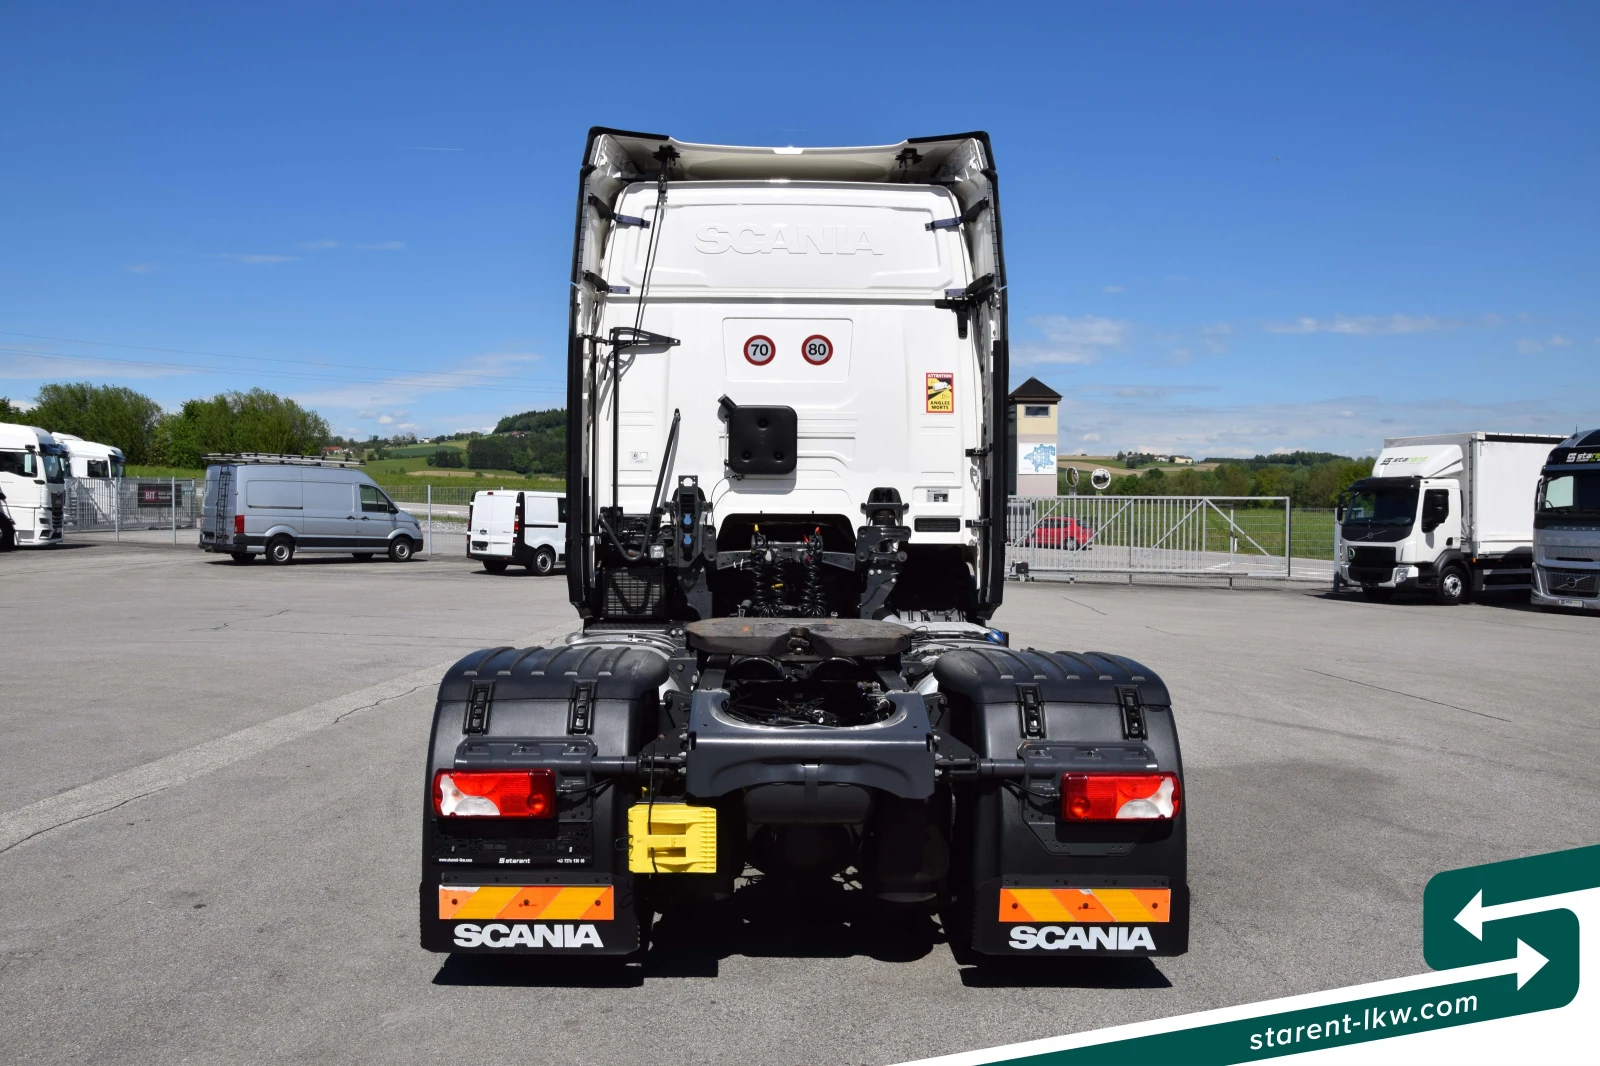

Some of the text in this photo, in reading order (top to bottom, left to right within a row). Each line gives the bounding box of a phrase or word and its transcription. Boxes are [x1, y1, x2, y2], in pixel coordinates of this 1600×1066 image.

[694, 222, 884, 256] SCANIA
[750, 343, 769, 356] 70
[808, 343, 827, 356] 80
[145, 491, 156, 500] BIT
[453, 923, 604, 948] SCANIA
[1008, 925, 1157, 951] SCANIA
